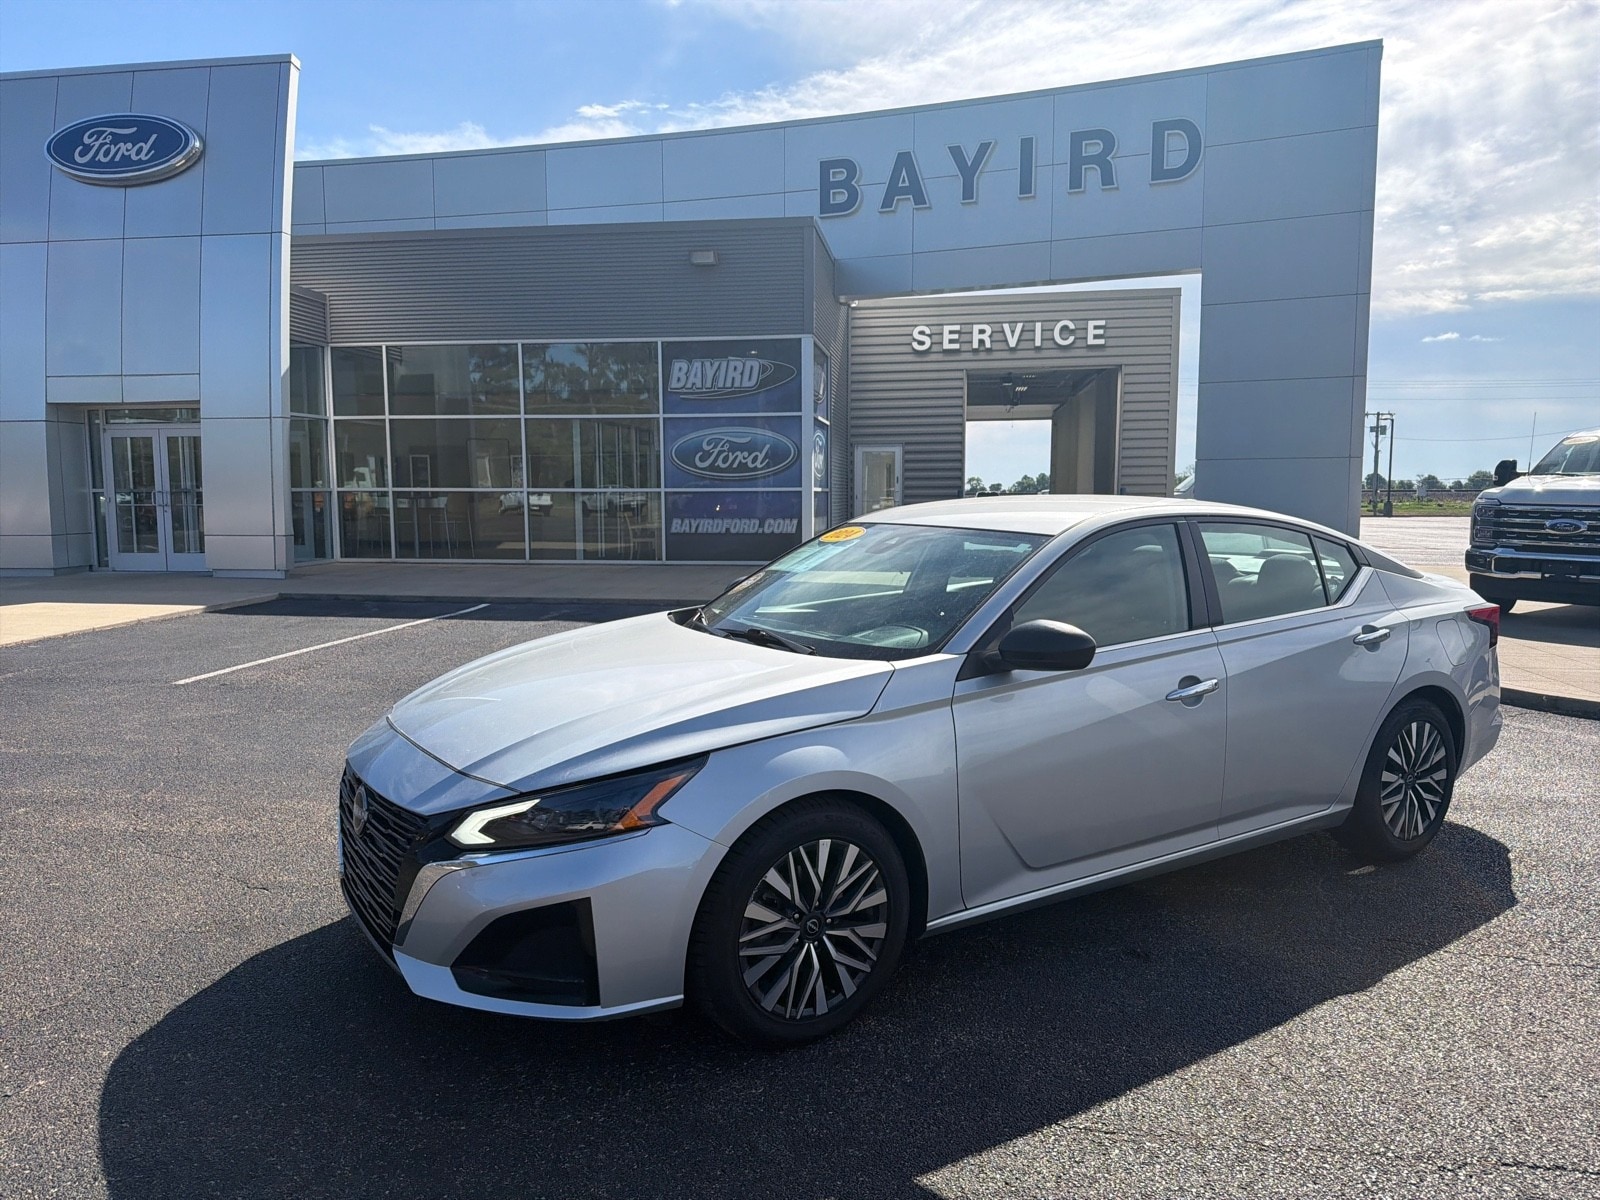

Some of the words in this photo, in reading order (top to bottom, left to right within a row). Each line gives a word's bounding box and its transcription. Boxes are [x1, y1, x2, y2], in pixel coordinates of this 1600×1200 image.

[74, 126, 158, 164] Ford
[818, 117, 1203, 218] BAYIRD
[911, 319, 1107, 352] SERVICE
[668, 358, 762, 391] BAYIRD
[694, 436, 770, 469] Ford
[670, 518, 798, 534] BAYIRDFORD.COM
